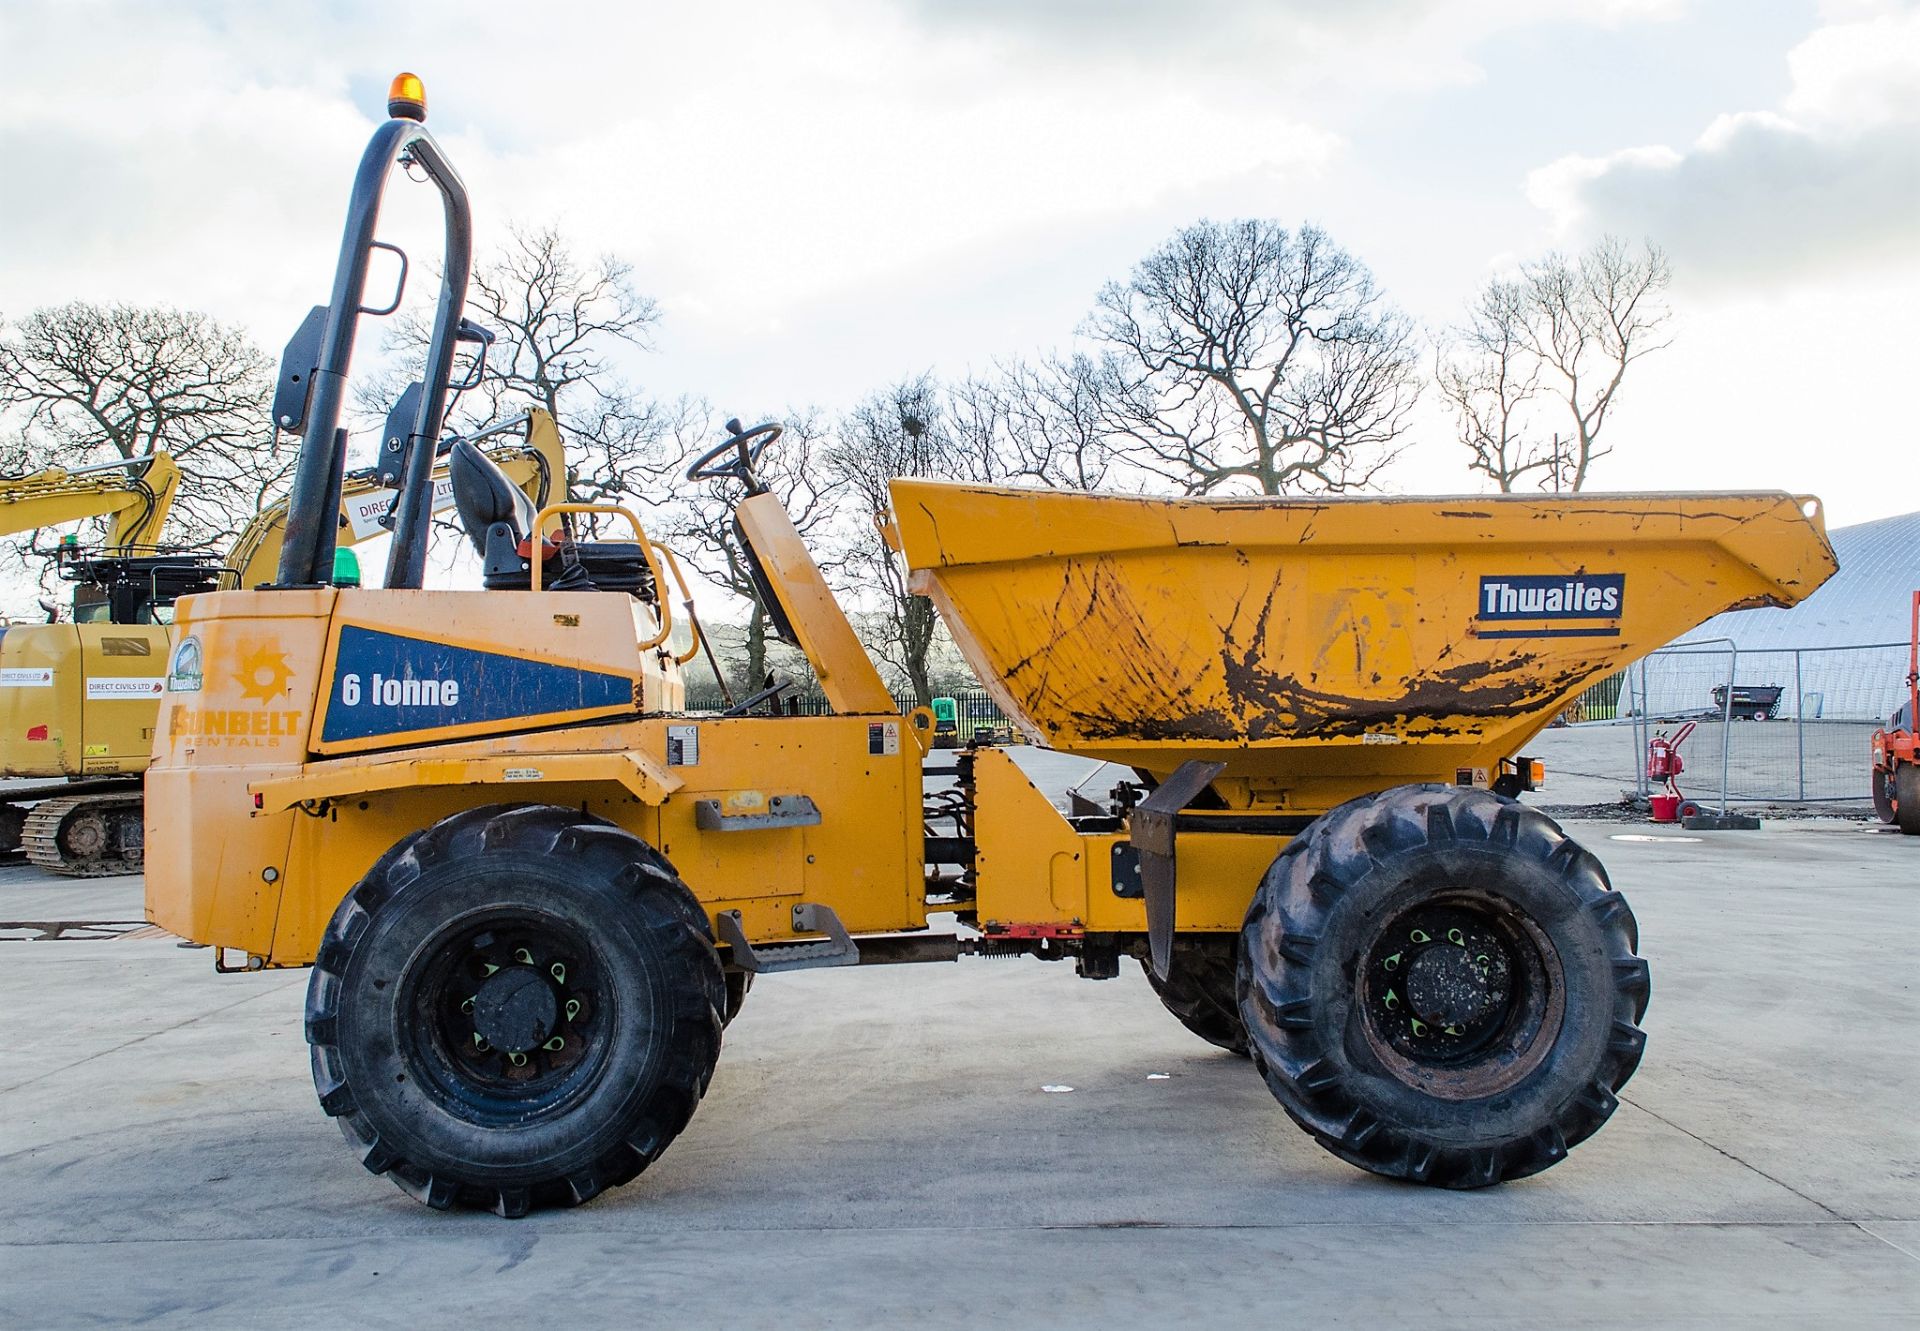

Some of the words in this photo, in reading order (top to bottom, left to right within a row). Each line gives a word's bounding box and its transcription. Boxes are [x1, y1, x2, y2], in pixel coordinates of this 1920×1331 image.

[360, 498, 392, 517] DIREC
[1484, 582, 1618, 613] Thwaites
[342, 673, 361, 706] 6
[372, 673, 459, 706] tonne
[184, 738, 280, 747] RENTALS
